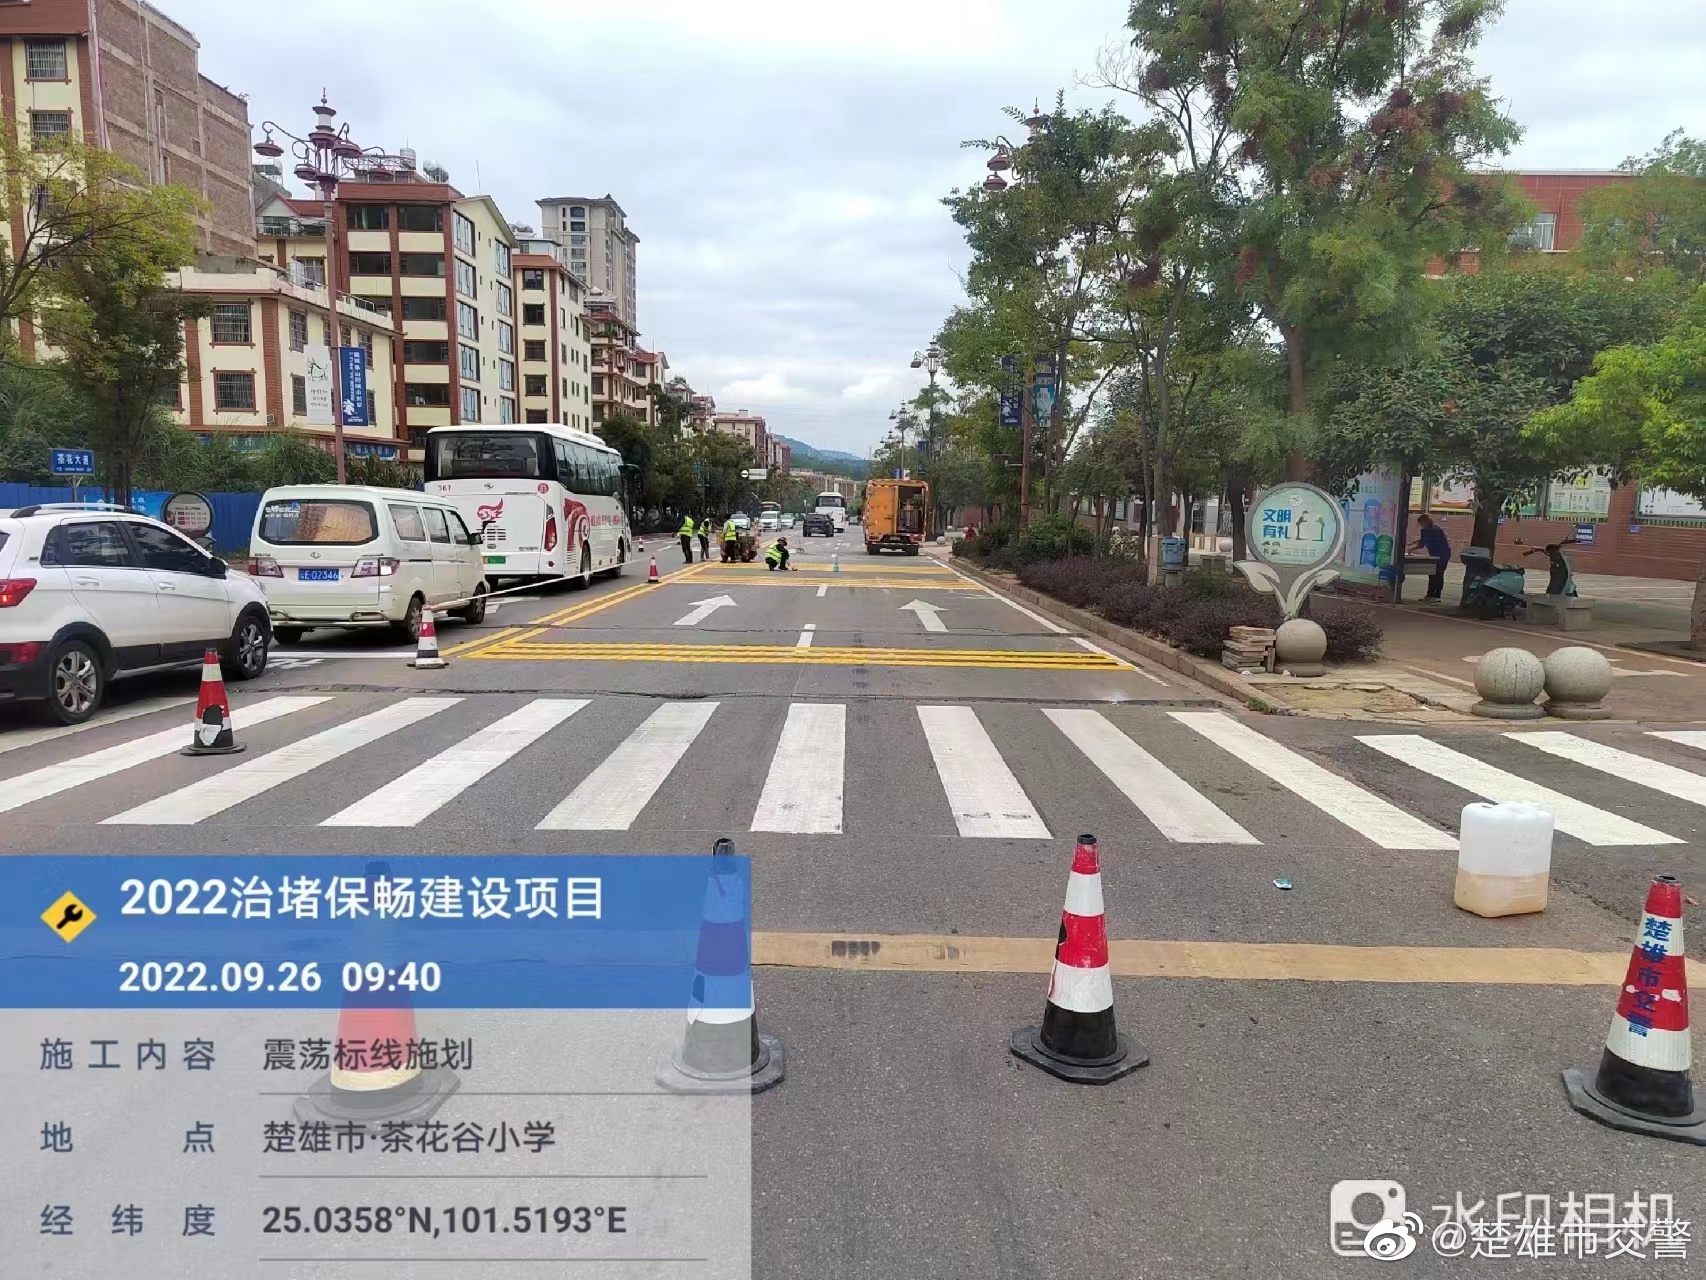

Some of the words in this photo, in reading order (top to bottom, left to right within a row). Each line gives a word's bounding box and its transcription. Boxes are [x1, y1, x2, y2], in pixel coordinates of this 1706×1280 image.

[57, 453, 89, 465] 茶花大道
[1262, 508, 1292, 523] 文明
[1262, 524, 1291, 539] 有礼
[1627, 916, 1672, 1038] 楚雄市交警
